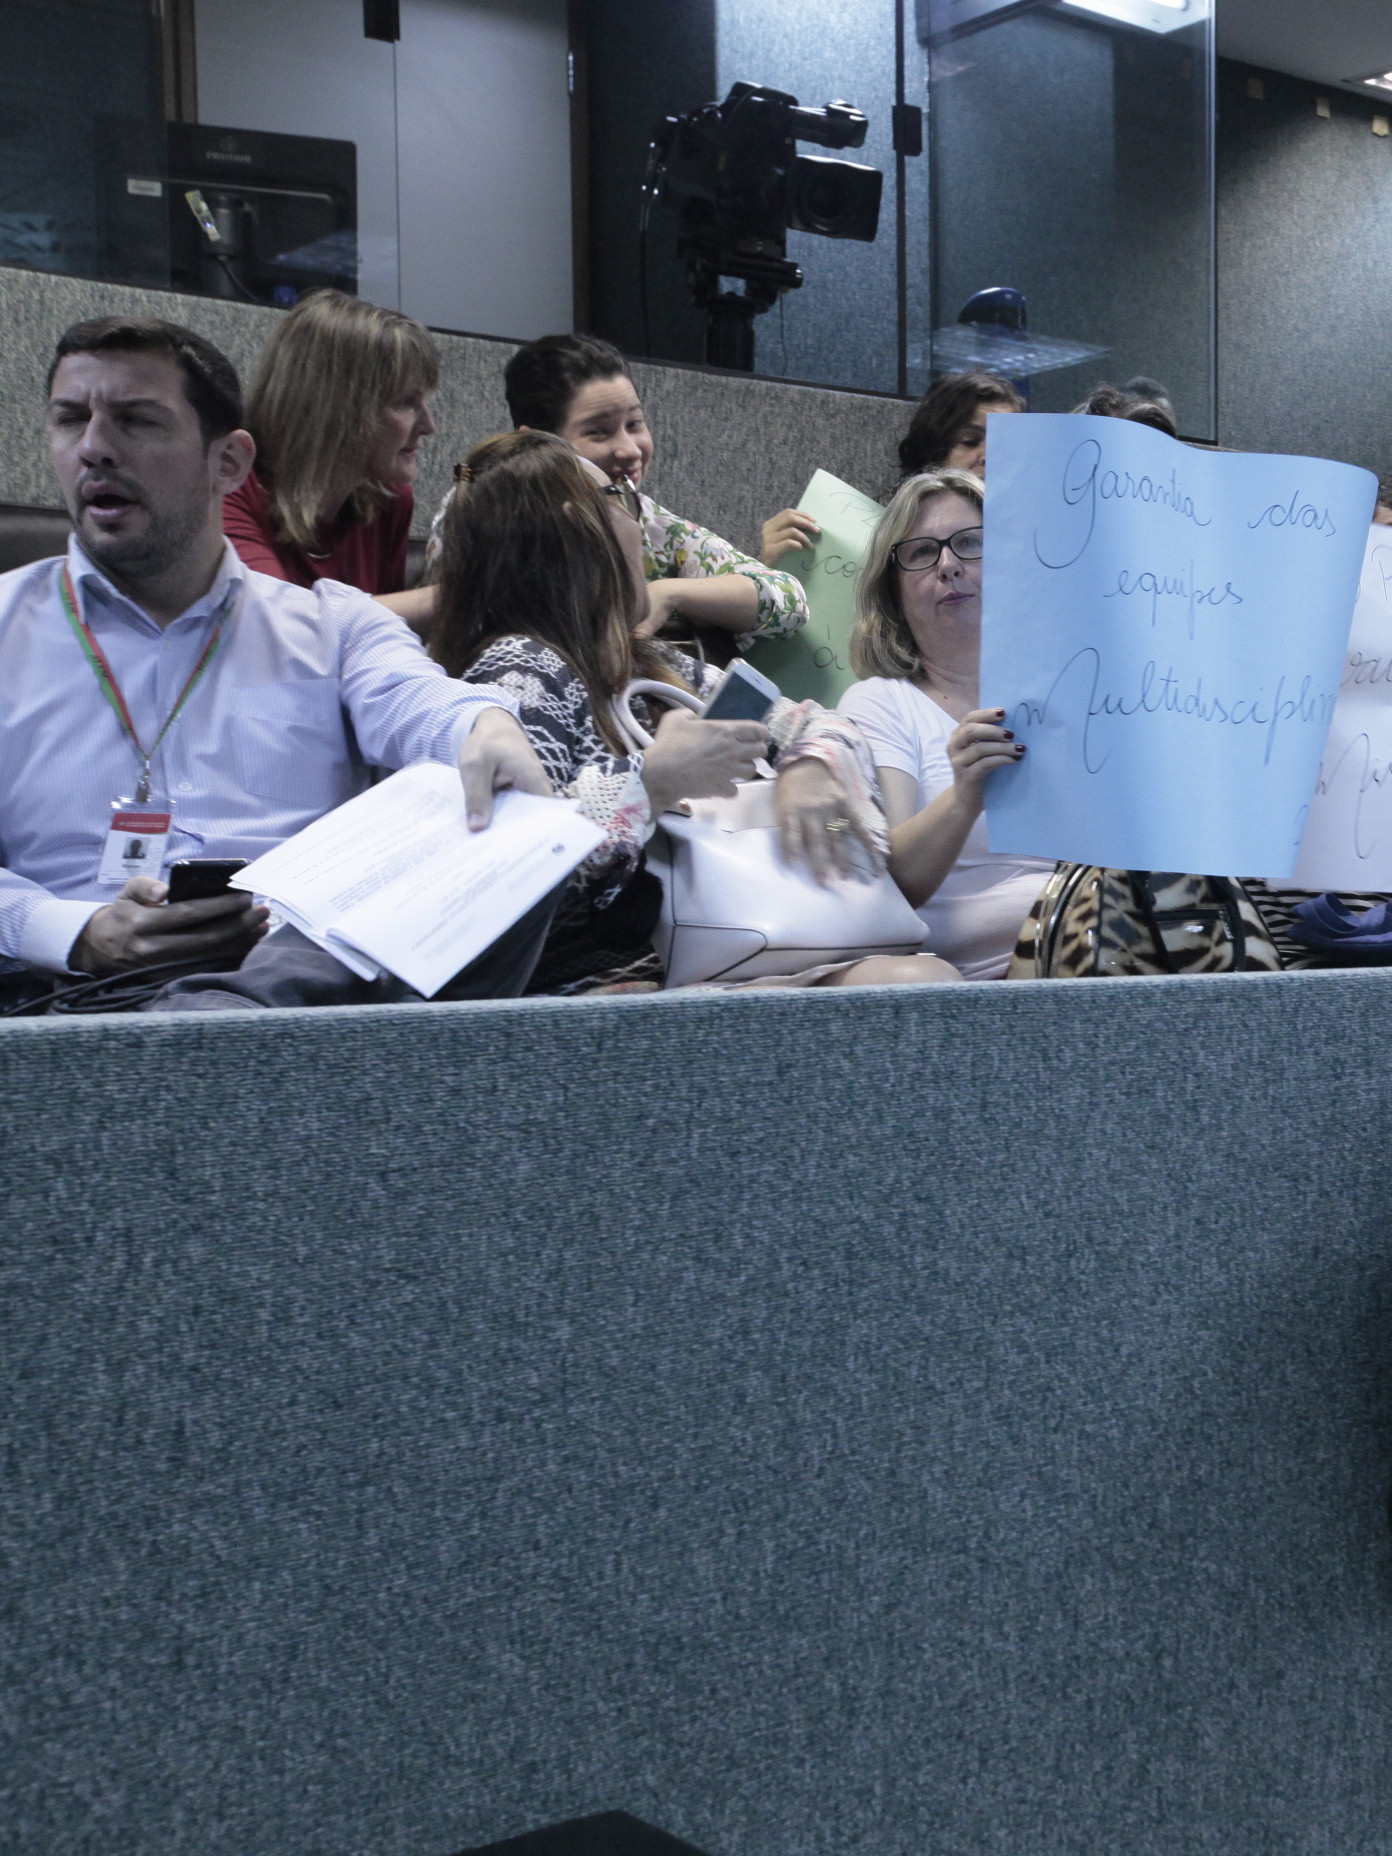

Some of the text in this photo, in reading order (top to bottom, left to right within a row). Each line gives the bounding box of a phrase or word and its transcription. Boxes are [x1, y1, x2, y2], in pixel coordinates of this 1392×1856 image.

[1034, 438, 1337, 570] Garantia das
[1101, 557, 1244, 641] equipes
